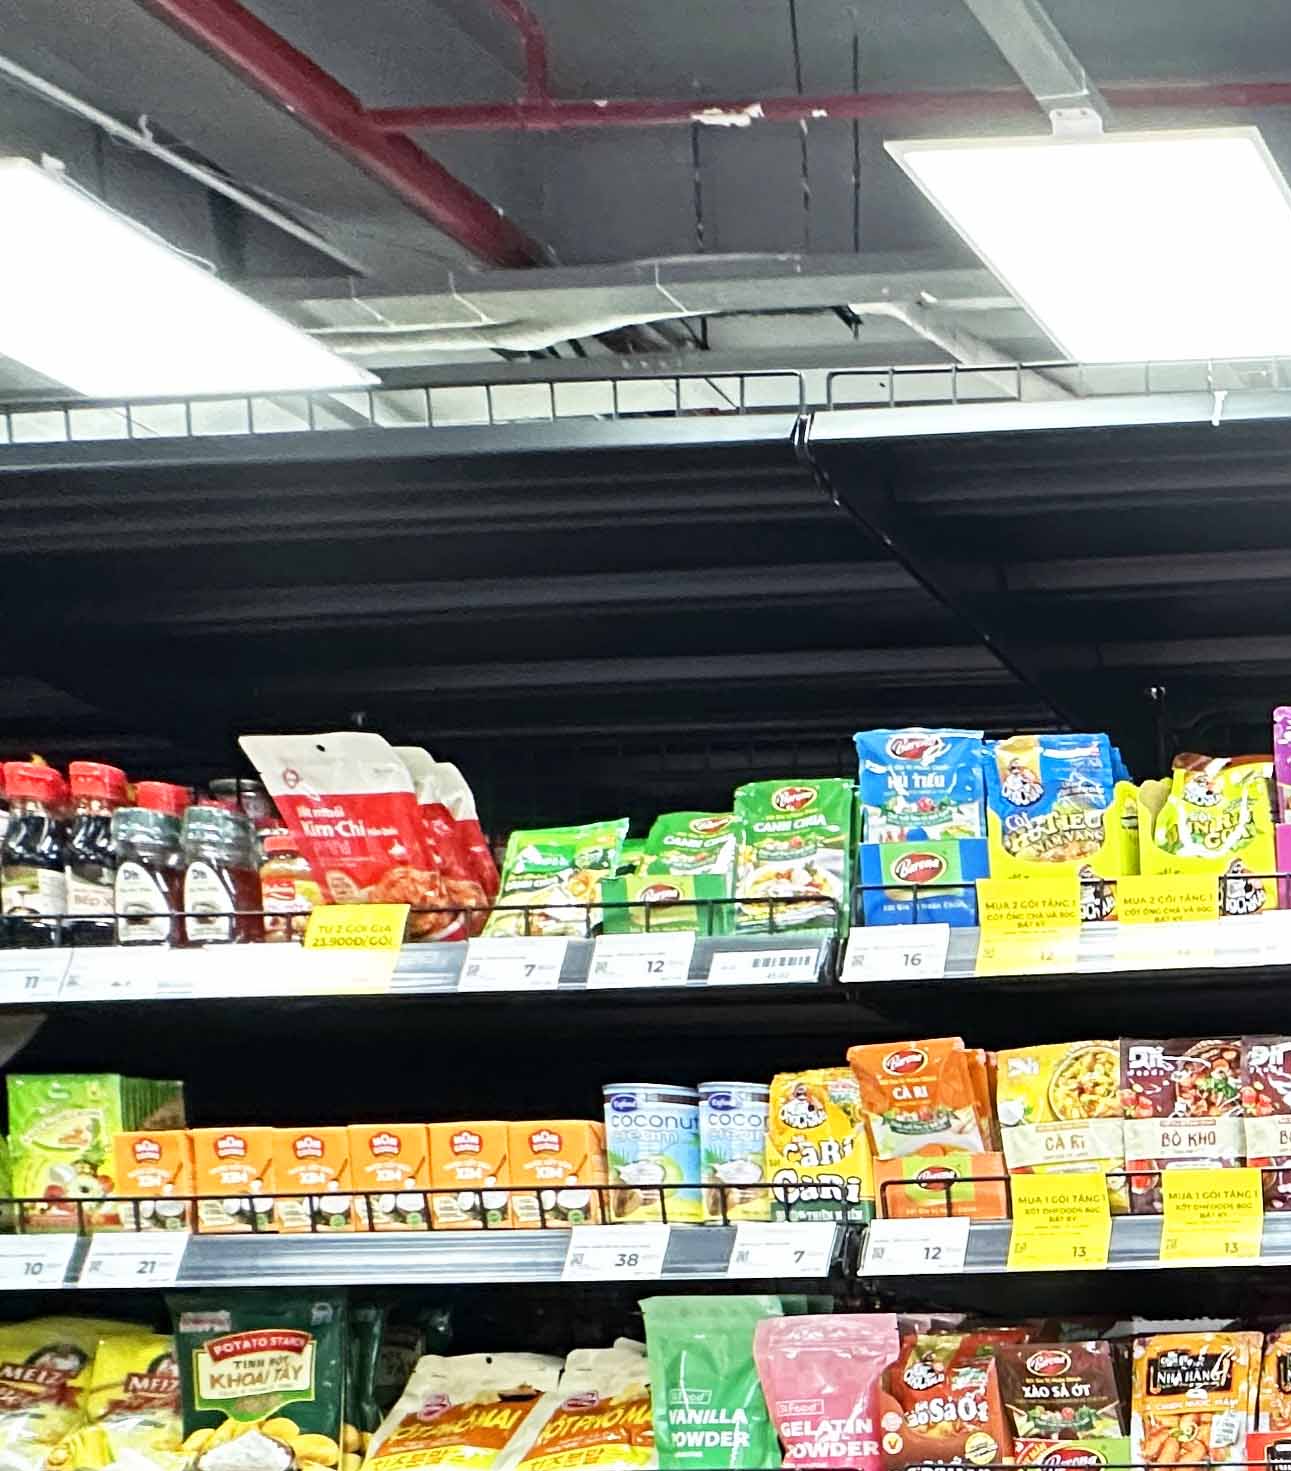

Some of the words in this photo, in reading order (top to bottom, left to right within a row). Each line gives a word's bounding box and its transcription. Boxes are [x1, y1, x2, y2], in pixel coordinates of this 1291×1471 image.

[904, 953, 922, 966] 16
[525, 964, 536, 977] 7
[648, 960, 664, 973] 12
[610, 1114, 698, 1130] coconut
[615, 1253, 639, 1267] 38
[136, 1261, 156, 1274] 21
[213, 1340, 263, 1354] POTATO
[670, 1408, 746, 1425] VANILLA
